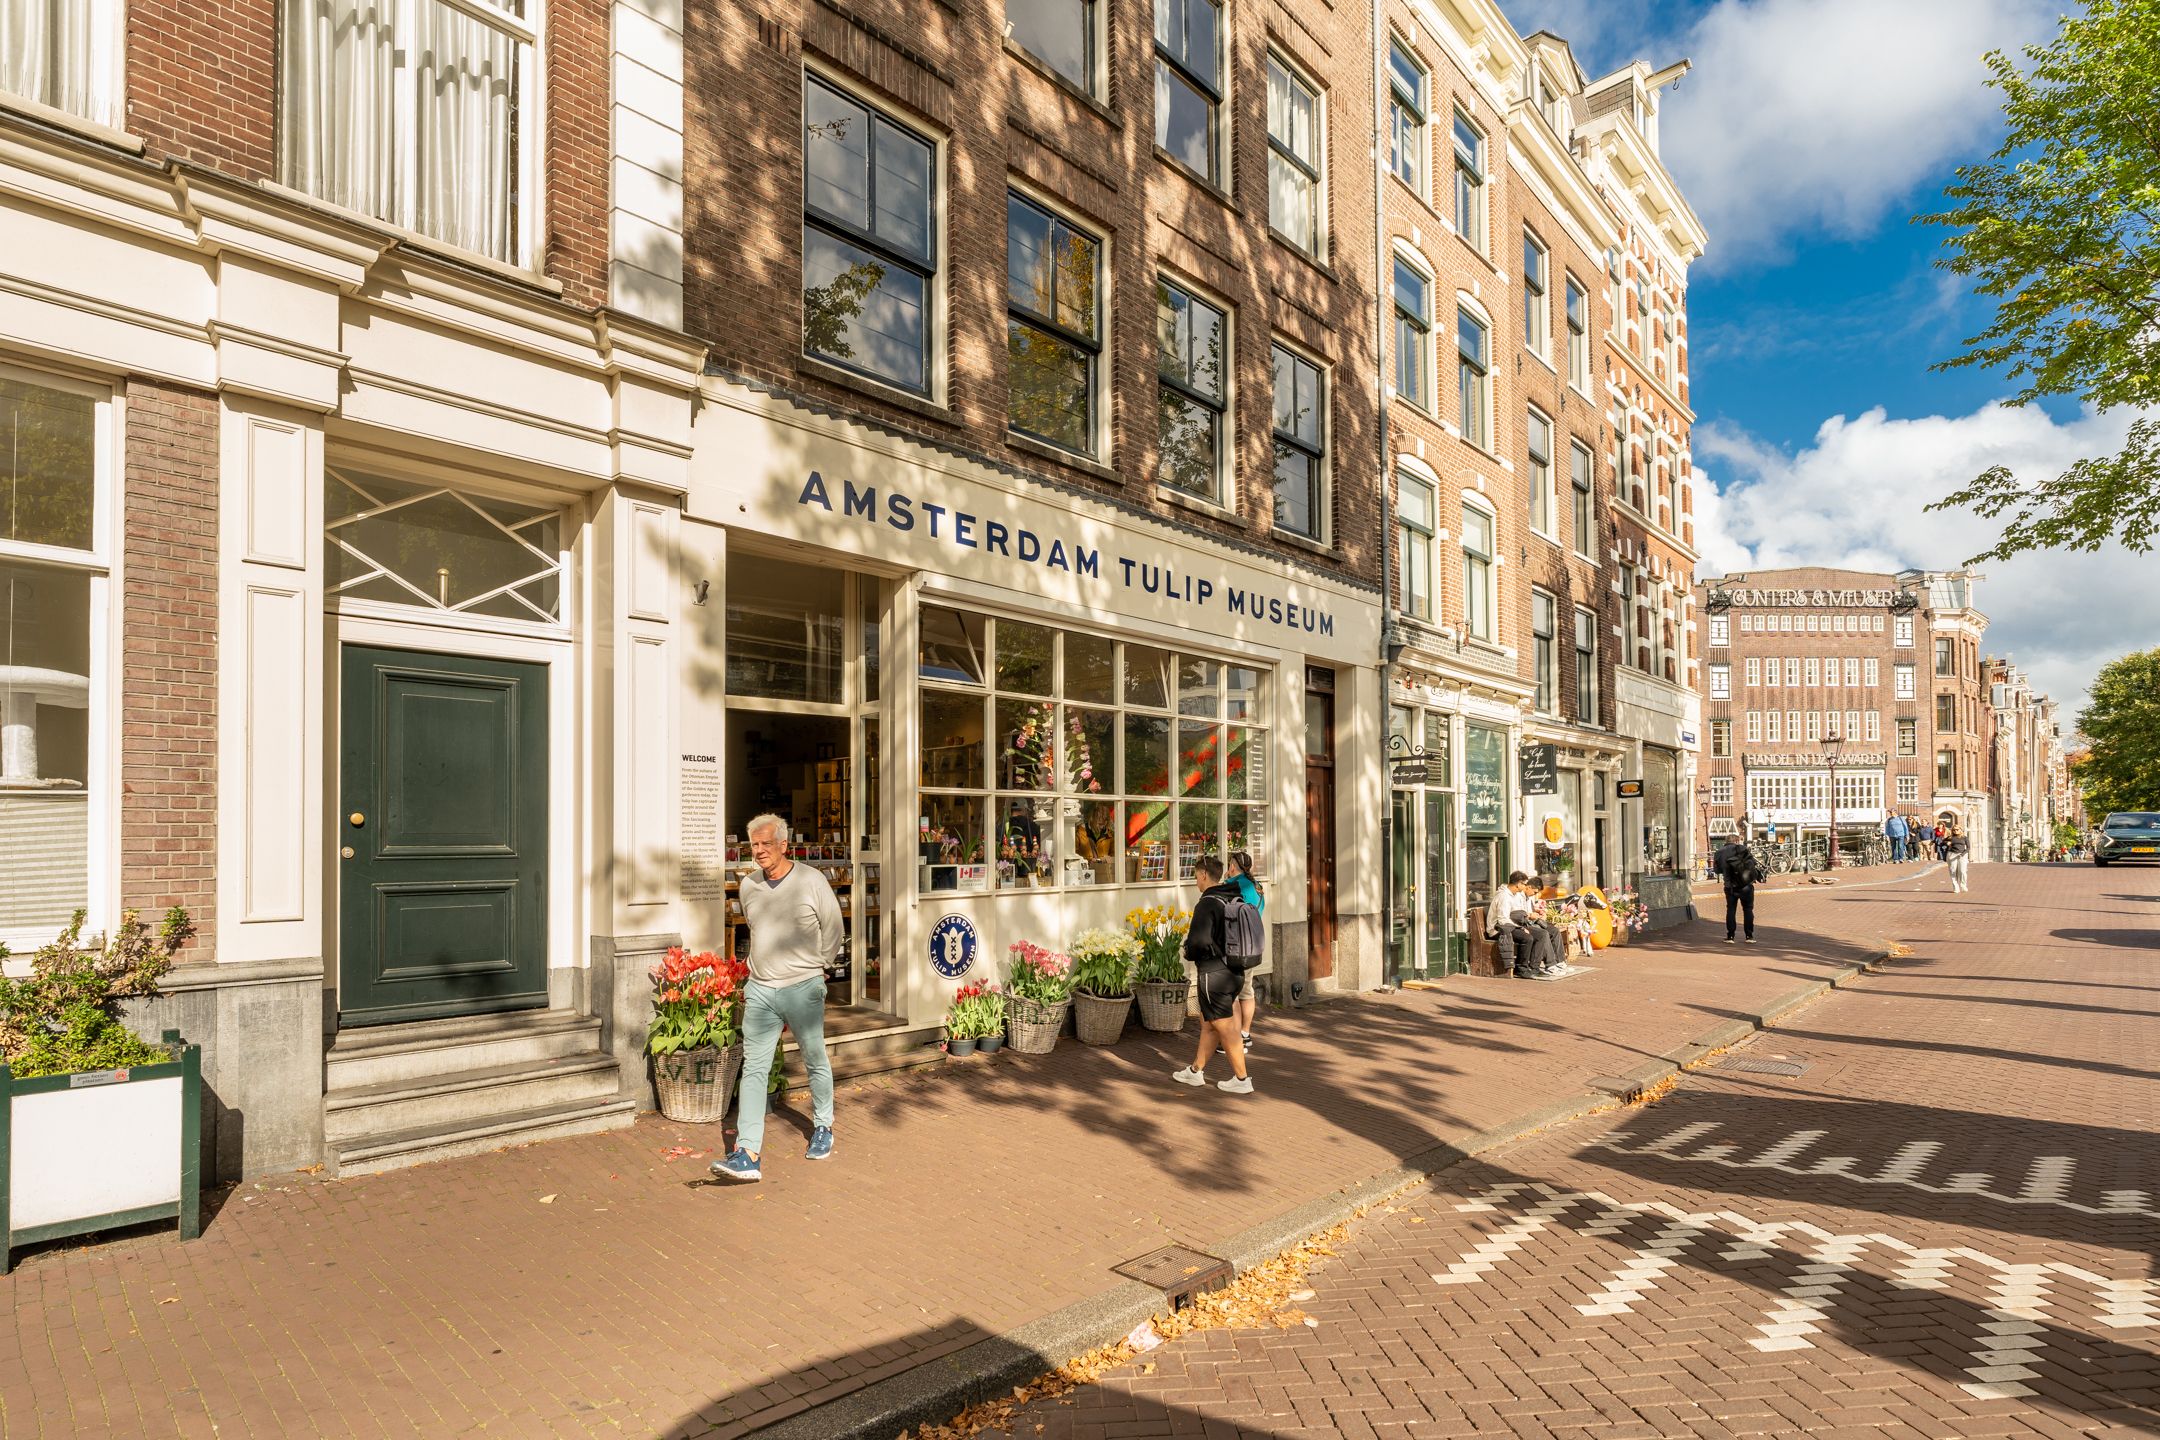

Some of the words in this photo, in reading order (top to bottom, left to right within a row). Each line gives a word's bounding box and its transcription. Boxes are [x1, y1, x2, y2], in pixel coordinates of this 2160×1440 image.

[798, 470, 1098, 579] AMSTERDAM
[1119, 557, 1213, 605] TULIP
[1228, 587, 1334, 637] MUSEUM
[1811, 589, 1826, 607] &
[1827, 589, 1893, 607] MEUSER
[681, 754, 716, 763] WELCOME
[1747, 754, 1793, 765] HANDEL
[1796, 754, 1809, 765] IN
[933, 917, 974, 941] AMSTERDAM
[932, 949, 947, 973] TULIP
[951, 945, 976, 976] MUSEUM
